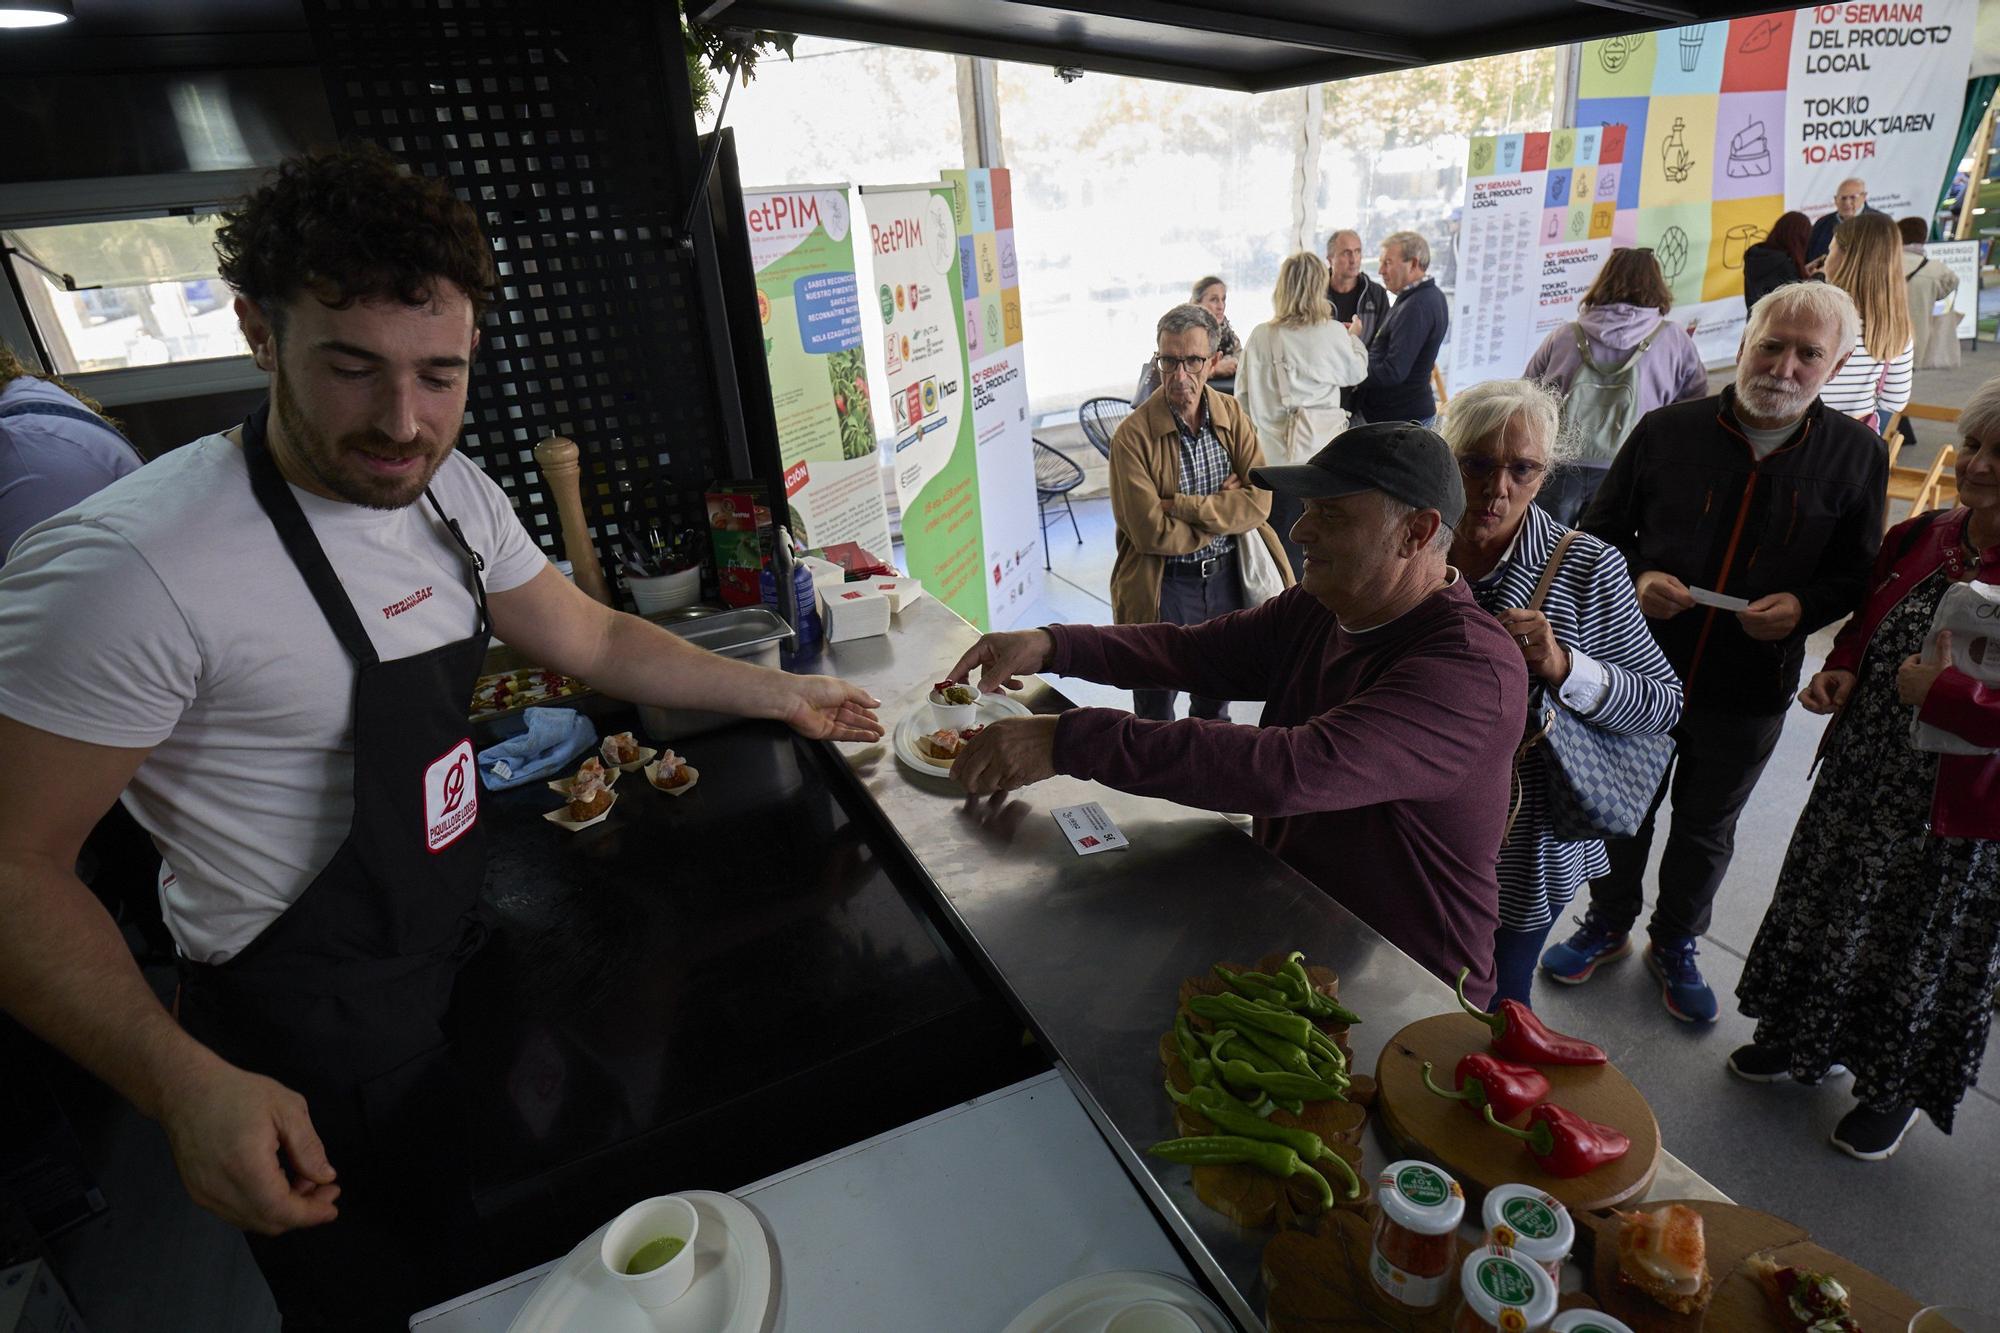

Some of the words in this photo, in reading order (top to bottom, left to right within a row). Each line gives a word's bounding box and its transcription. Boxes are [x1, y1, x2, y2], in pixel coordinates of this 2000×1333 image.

[1844, 3, 1923, 24] SEMANA
[1808, 29, 1844, 49] DEL
[1848, 25, 1952, 48] PRODUCTO
[1806, 53, 1871, 74] LOCAL
[1803, 96, 1870, 117] TOKIKO
[1802, 113, 1936, 141] PRODUKTUAREN
[1473, 192, 1487, 200] DEL
[1489, 186, 1533, 197] PRODUCTO
[1487, 179, 1521, 190] SEMANA
[748, 194, 822, 233] etPIM
[1472, 200, 1498, 209] LOCAL
[871, 217, 923, 256] RetPIM
[1543, 260, 1556, 268] DEL
[1558, 254, 1598, 265] PRODUCTO
[1557, 248, 1588, 257] SEMANA
[1543, 266, 1565, 276] LOCAL
[982, 360, 1009, 380] SEMANA
[973, 385, 985, 398] DEL
[985, 368, 1018, 390] PRODUCTO
[975, 393, 995, 411] LOCAL
[430, 815, 453, 839] PIQUILLO
[453, 811, 461, 824] DE
